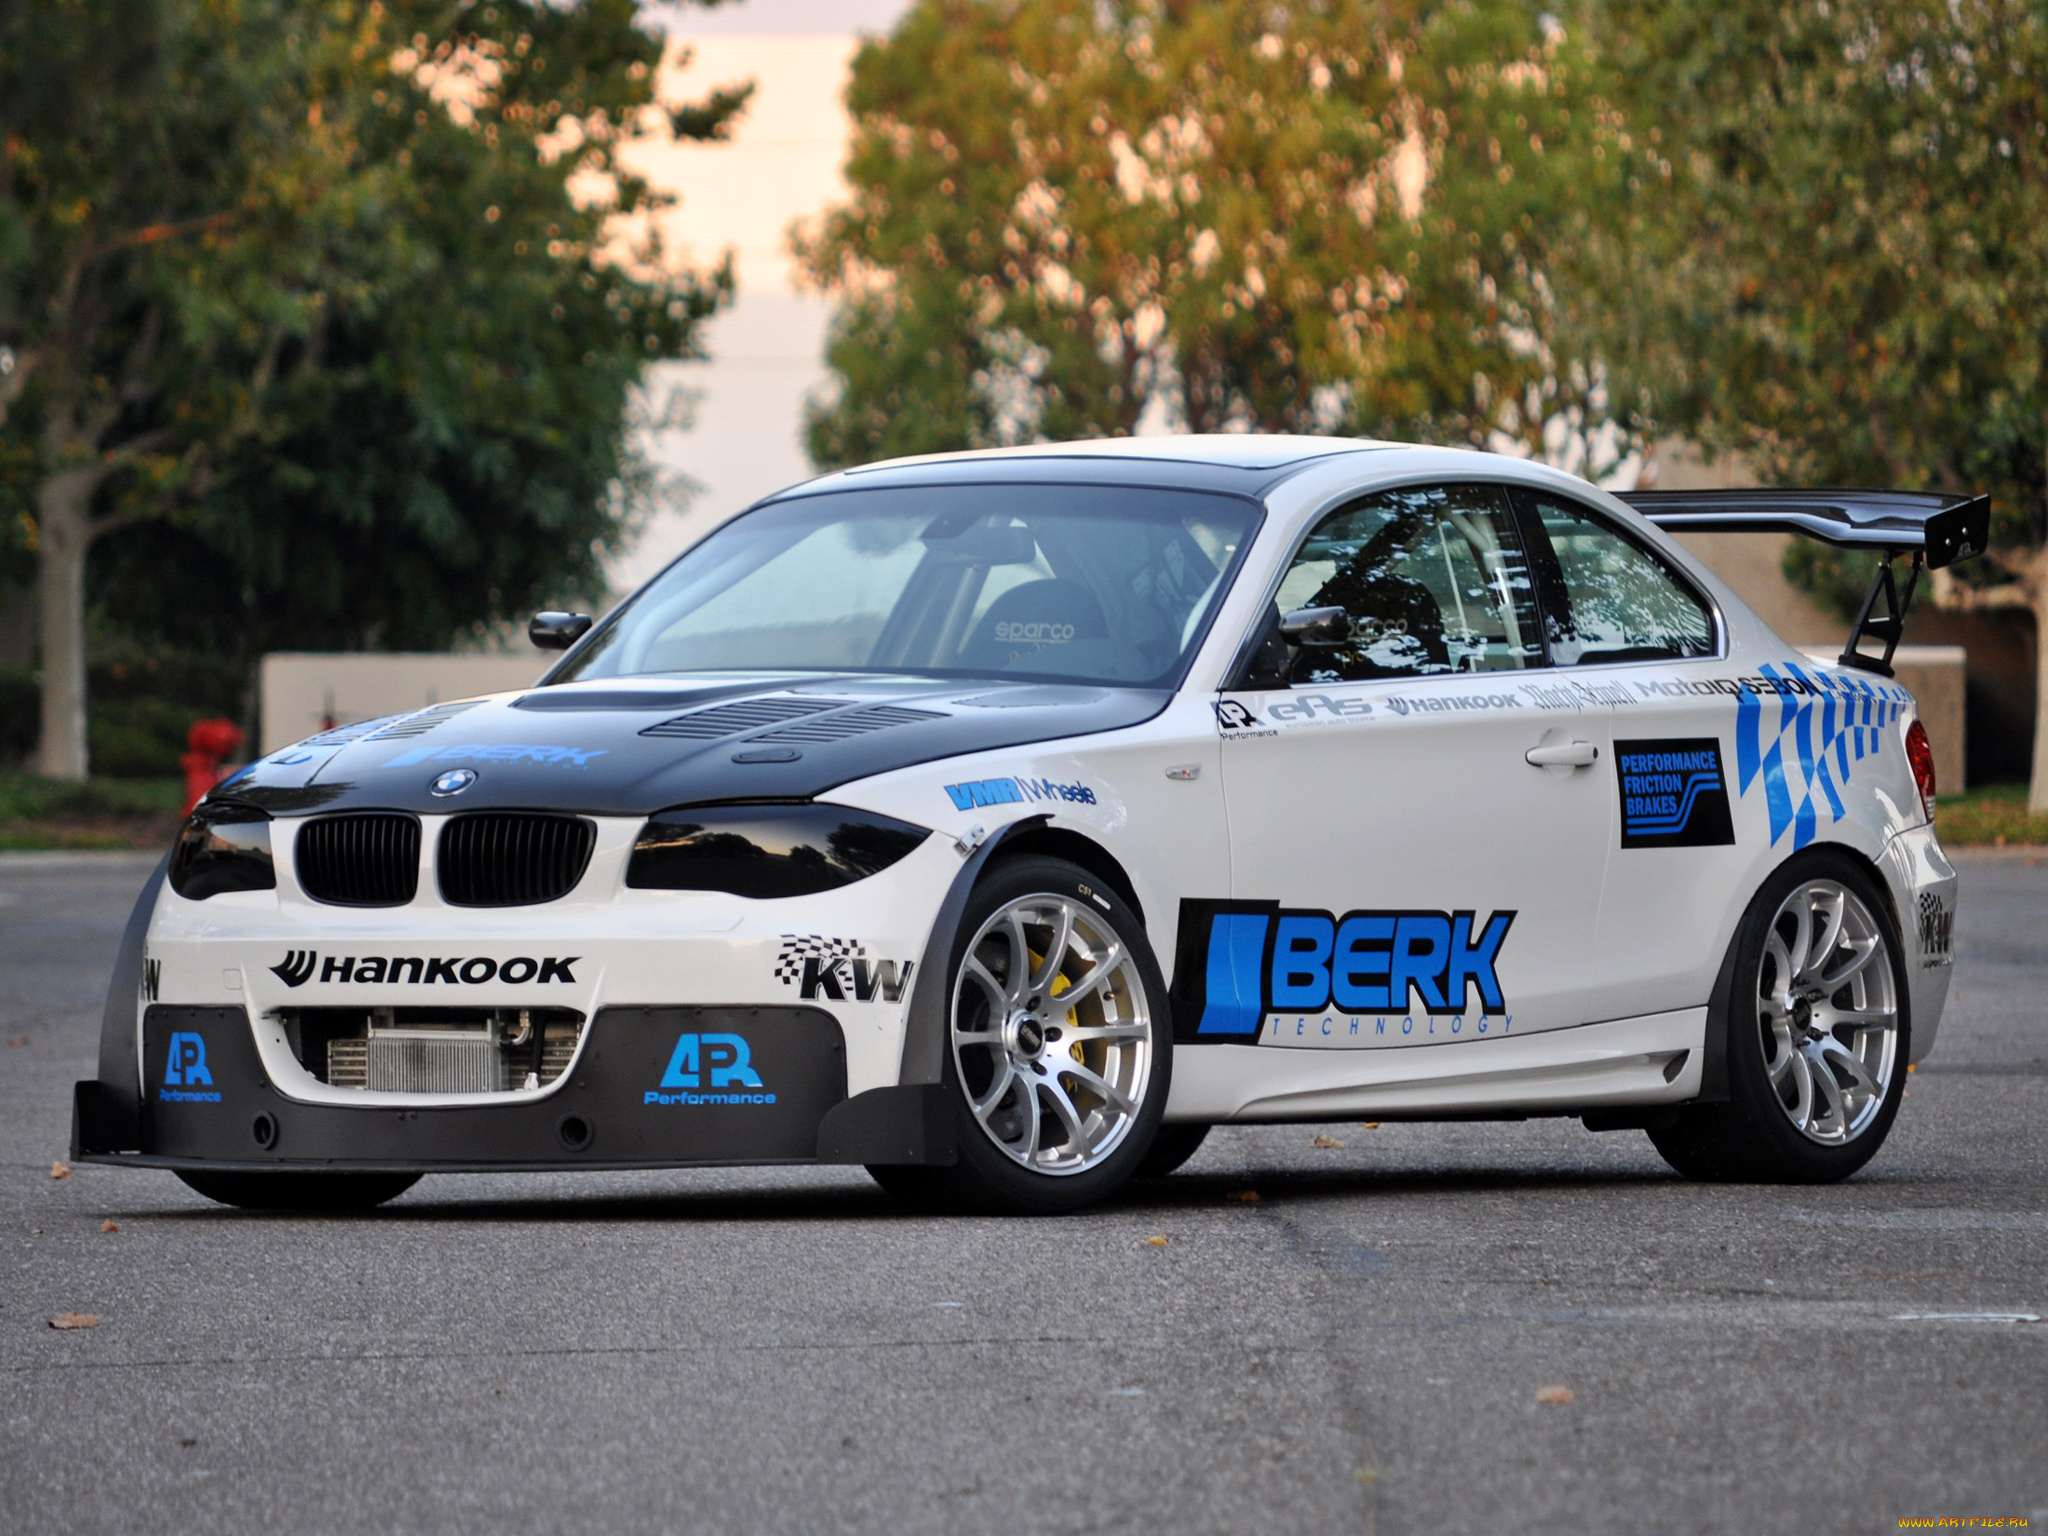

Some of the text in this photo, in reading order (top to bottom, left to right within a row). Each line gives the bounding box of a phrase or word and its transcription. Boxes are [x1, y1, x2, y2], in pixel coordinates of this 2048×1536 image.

[995, 621, 1075, 642] sparco
[1221, 729, 1278, 741] Performance
[1621, 751, 1717, 773] PERFORMANCE
[1624, 774, 1682, 794] FRICTION
[1626, 795, 1678, 816] BRAKES
[1270, 909, 1516, 1014] BERK
[800, 956, 915, 1003] KW
[1273, 1015, 1513, 1036] TECHNOLOGY
[160, 1088, 222, 1103] Performance
[643, 1091, 777, 1105] Performance
